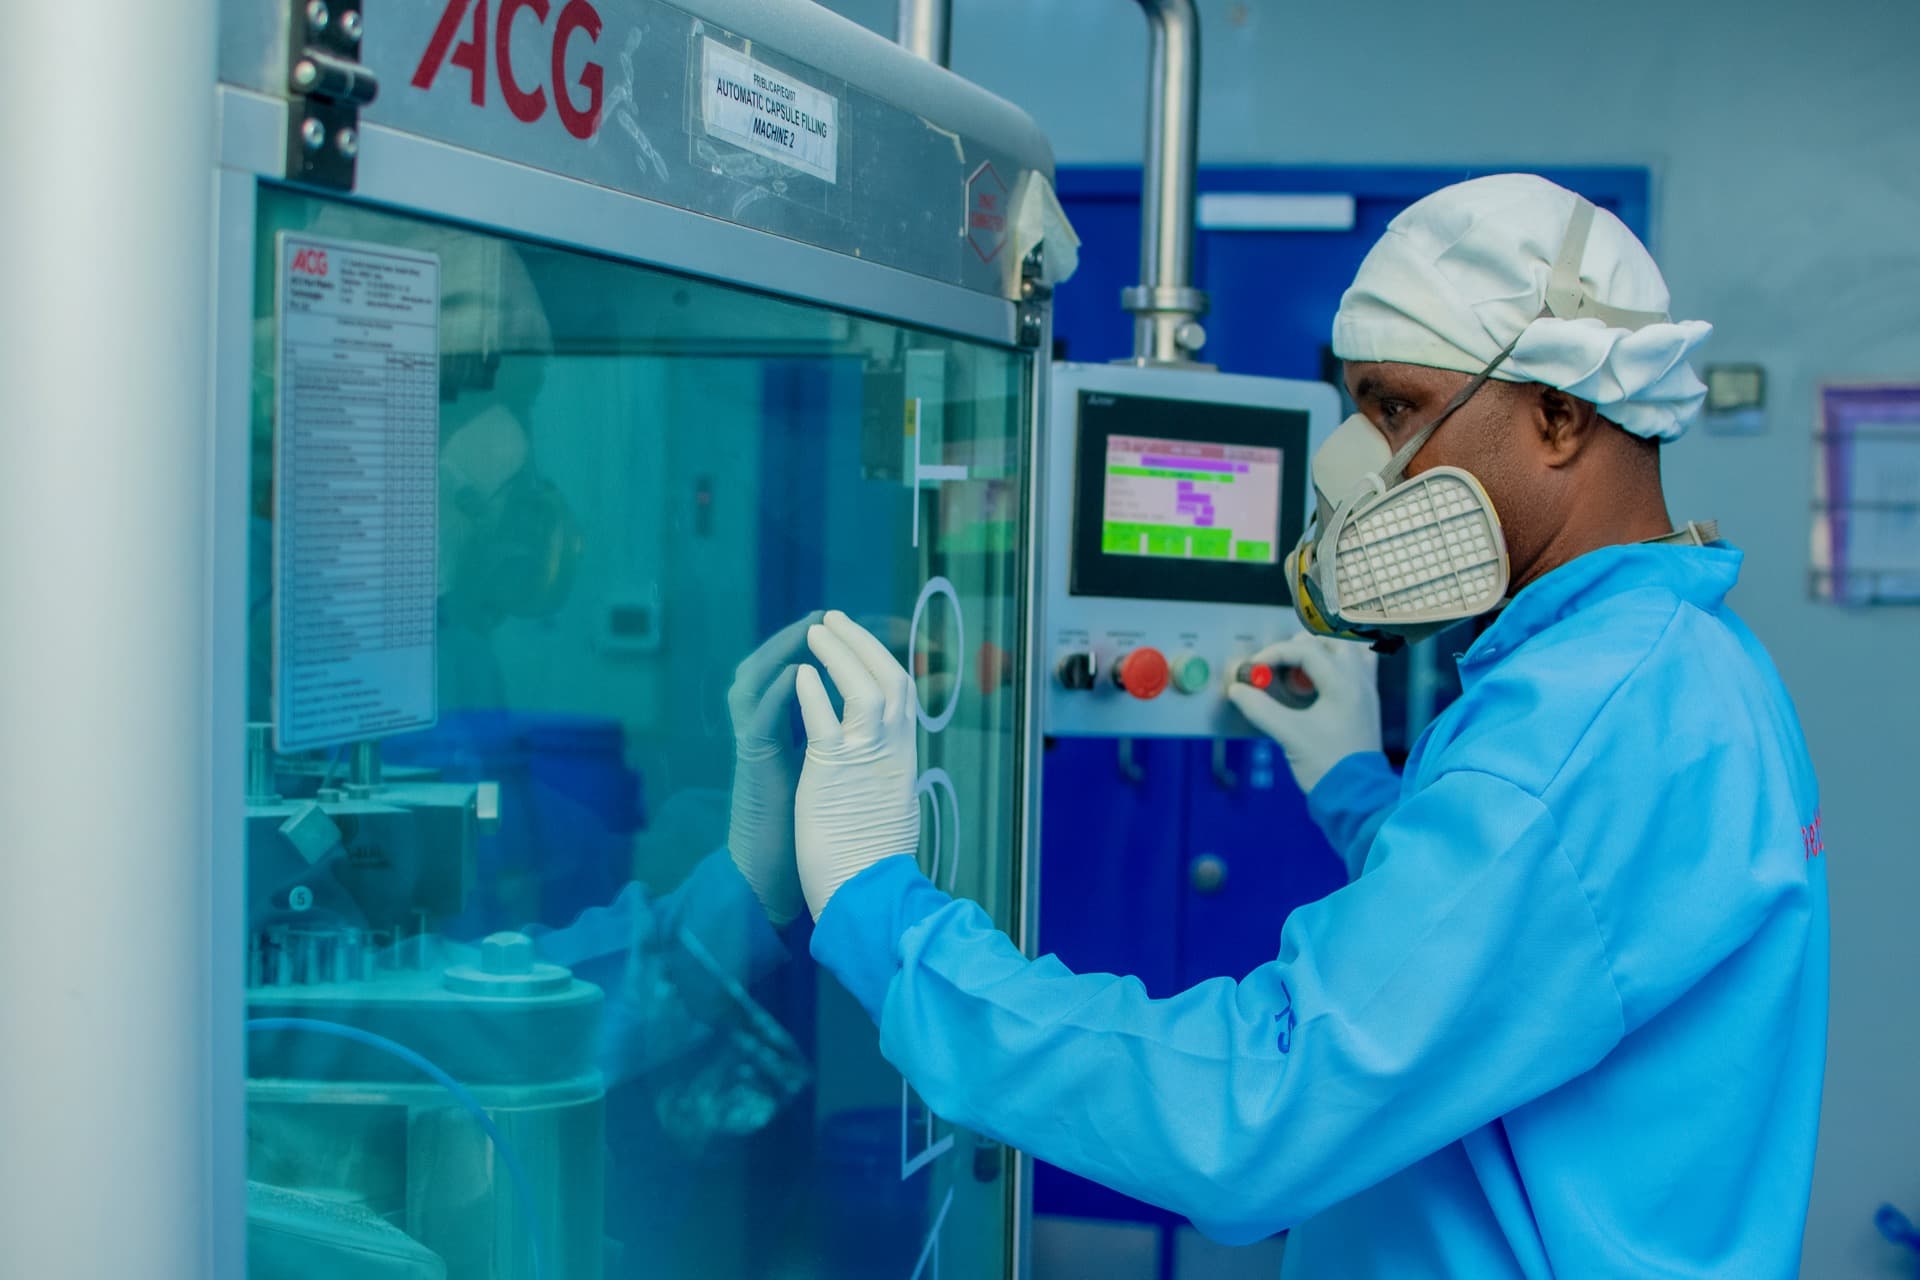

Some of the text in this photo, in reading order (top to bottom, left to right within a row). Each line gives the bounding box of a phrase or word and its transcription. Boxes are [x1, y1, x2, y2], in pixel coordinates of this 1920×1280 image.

[410, 0, 604, 140] ACG
[716, 78, 827, 138] AUTOMATIC CAPSULE FILLING
[753, 117, 795, 148] MACHINE 2
[291, 249, 328, 276] ACG
